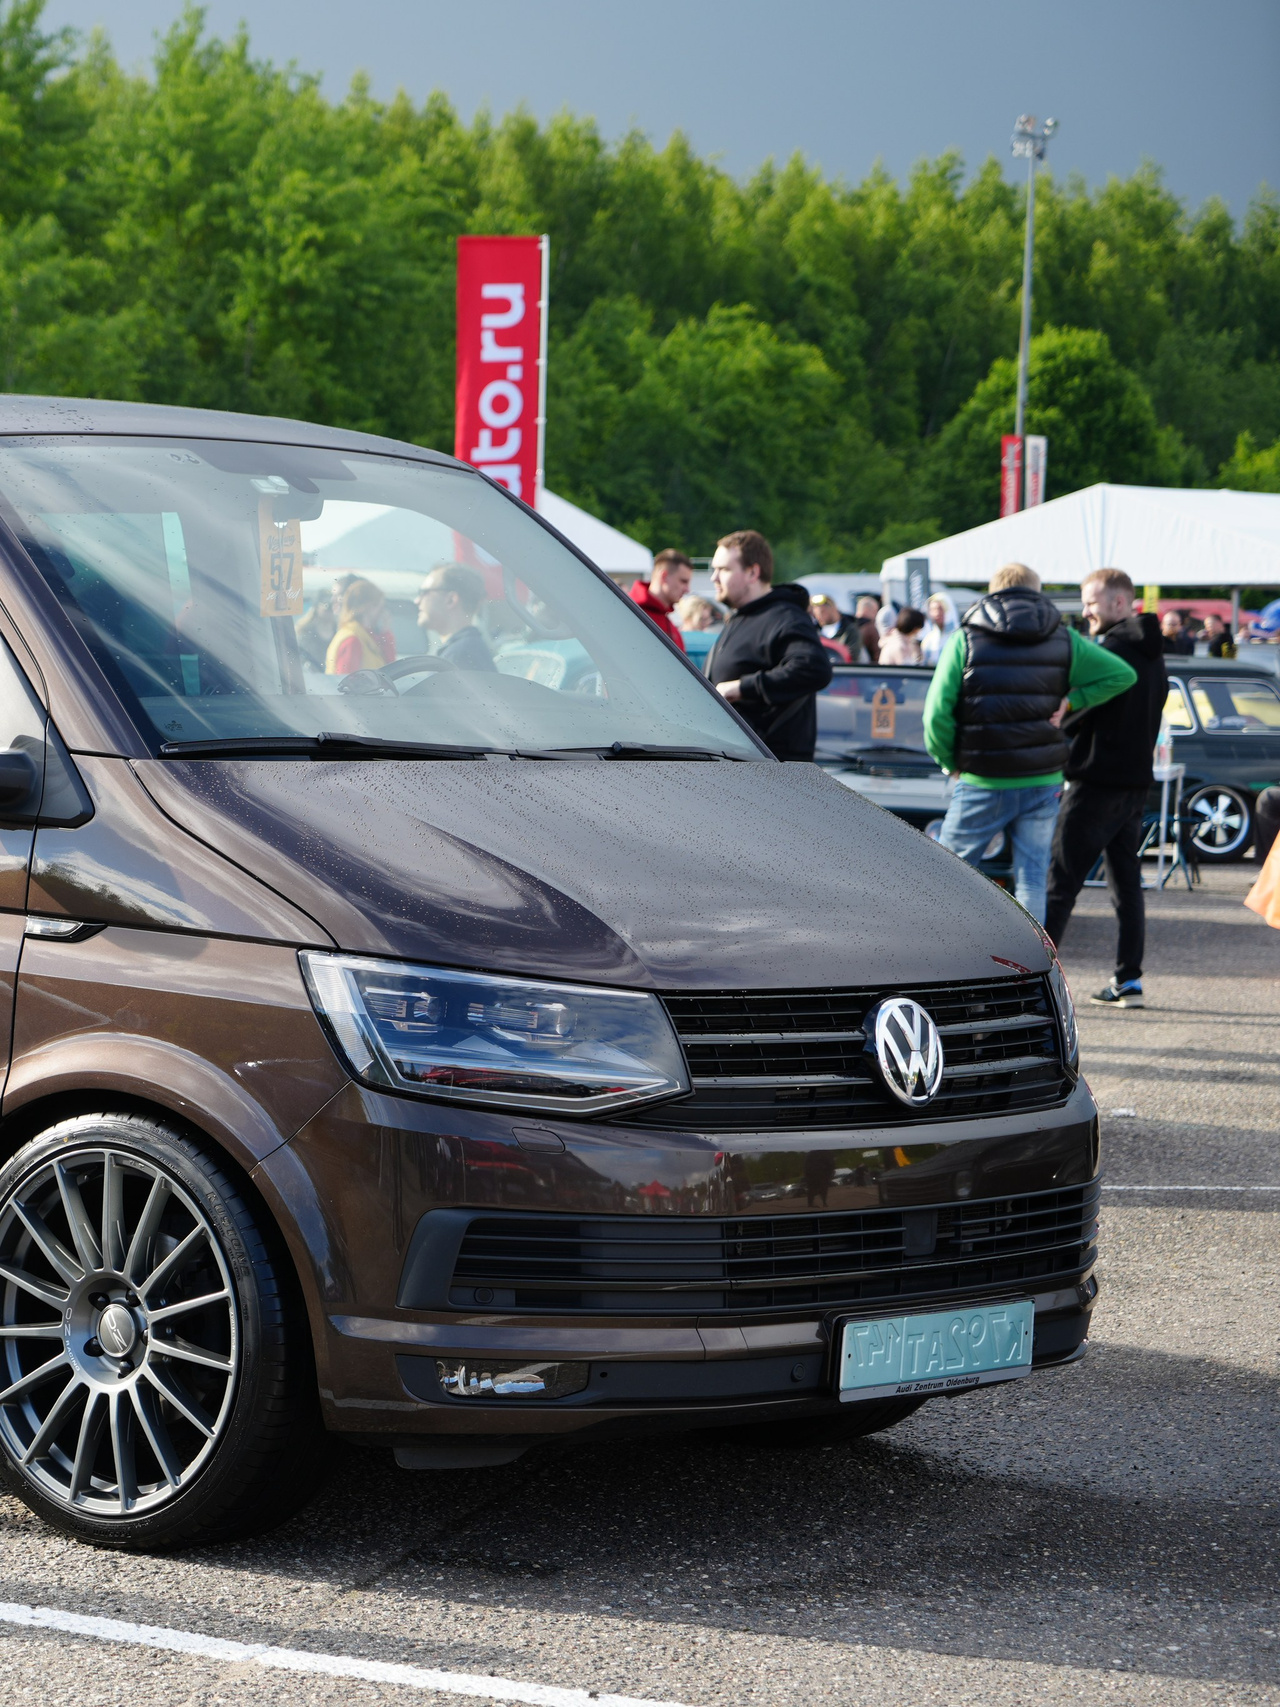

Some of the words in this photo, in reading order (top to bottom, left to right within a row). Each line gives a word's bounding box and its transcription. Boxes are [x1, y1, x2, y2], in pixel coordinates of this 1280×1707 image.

[270, 553, 294, 591] 57
[876, 998, 942, 1104] VW
[65, 1340, 81, 1372] RACING
[895, 1384, 913, 1394] Audi
[913, 1380, 944, 1392] Zentrum
[945, 1376, 980, 1387] Oldenburg
